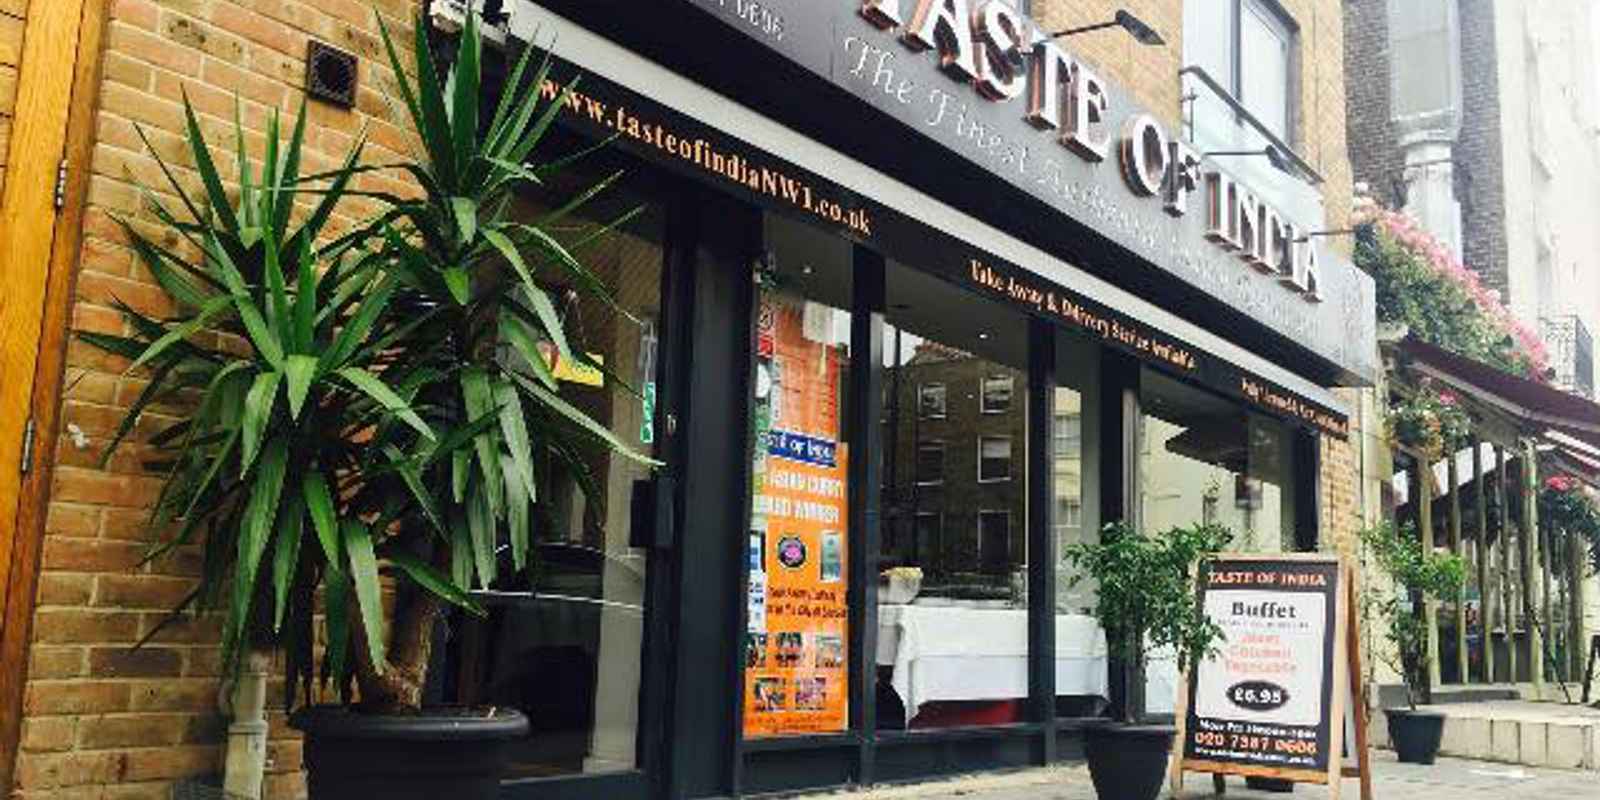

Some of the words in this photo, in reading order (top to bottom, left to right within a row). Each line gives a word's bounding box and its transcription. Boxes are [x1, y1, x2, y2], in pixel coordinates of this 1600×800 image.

[844, 36, 912, 104] The
[927, 88, 1029, 173] Finest
[1120, 114, 1202, 218] OF
[1203, 171, 1323, 302] INDIA
[969, 259, 1004, 292] Take
[1007, 277, 1044, 312] Away
[1047, 293, 1059, 314] &
[1061, 299, 1109, 339] Delivery
[1112, 320, 1150, 351] Service
[1207, 571, 1253, 585] TASTE
[1257, 572, 1275, 585] OF
[1280, 573, 1327, 586] INDIA
[1232, 602, 1297, 619] Buffet
[1234, 687, 1282, 703] £6.95
[1195, 732, 1224, 746] 020
[1231, 734, 1270, 751] 7387
